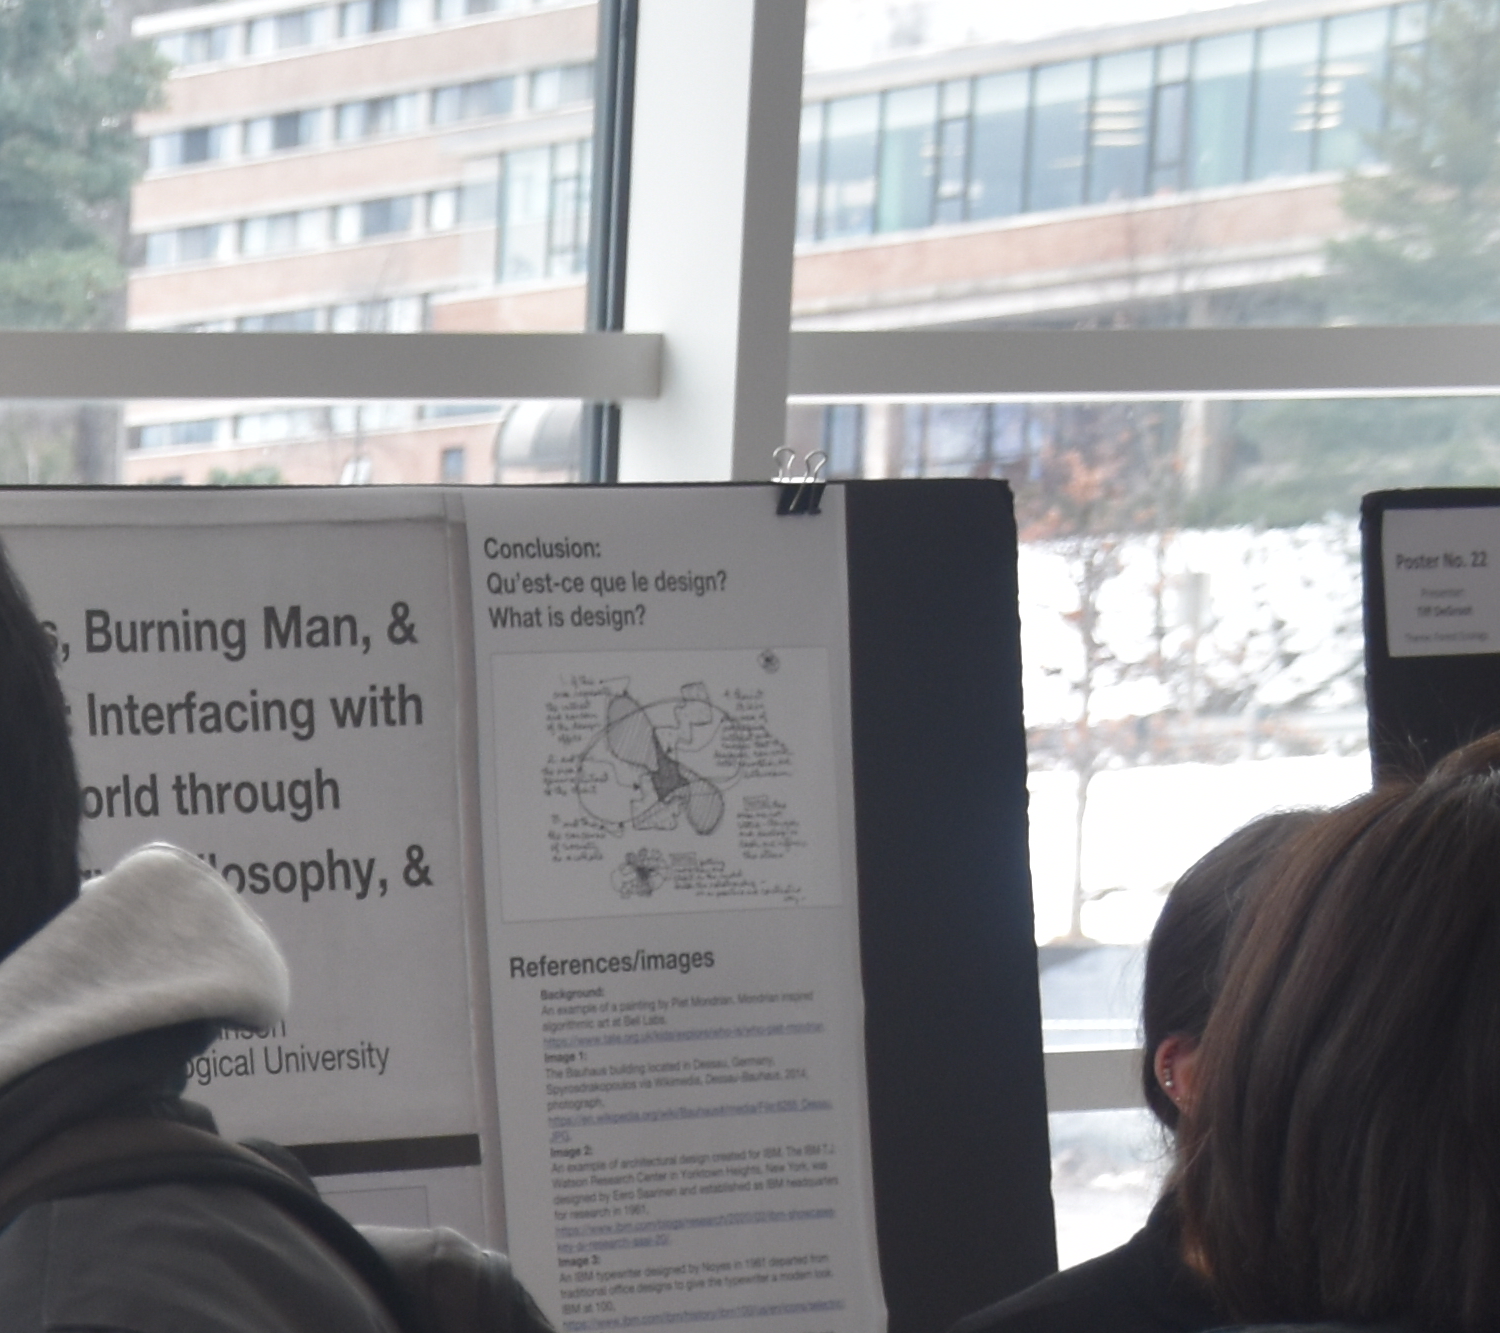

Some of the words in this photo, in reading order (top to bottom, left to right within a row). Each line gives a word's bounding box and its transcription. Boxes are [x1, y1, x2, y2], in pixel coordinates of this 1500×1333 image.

[484, 537, 601, 560] Conclusion:
[1395, 553, 1440, 570] Poster
[1442, 552, 1467, 569] No.
[1470, 550, 1488, 568] 22
[487, 572, 584, 595] Qu'est-ce
[590, 576, 626, 597] que
[632, 570, 649, 592] le
[654, 569, 727, 597] design?
[85, 608, 246, 660] Burning
[263, 605, 371, 654] Man,
[387, 601, 418, 645] &
[488, 606, 542, 629] What
[548, 606, 564, 627] is
[570, 604, 646, 631] design?
[87, 689, 315, 742] Interfacing
[330, 683, 423, 729] with
[80, 773, 160, 820] orld
[172, 767, 340, 822] through
[198, 847, 388, 903] osophy,
[403, 844, 434, 888] &
[510, 949, 715, 979] References/images
[540, 987, 604, 1001] Background:
[264, 1041, 389, 1075] University
